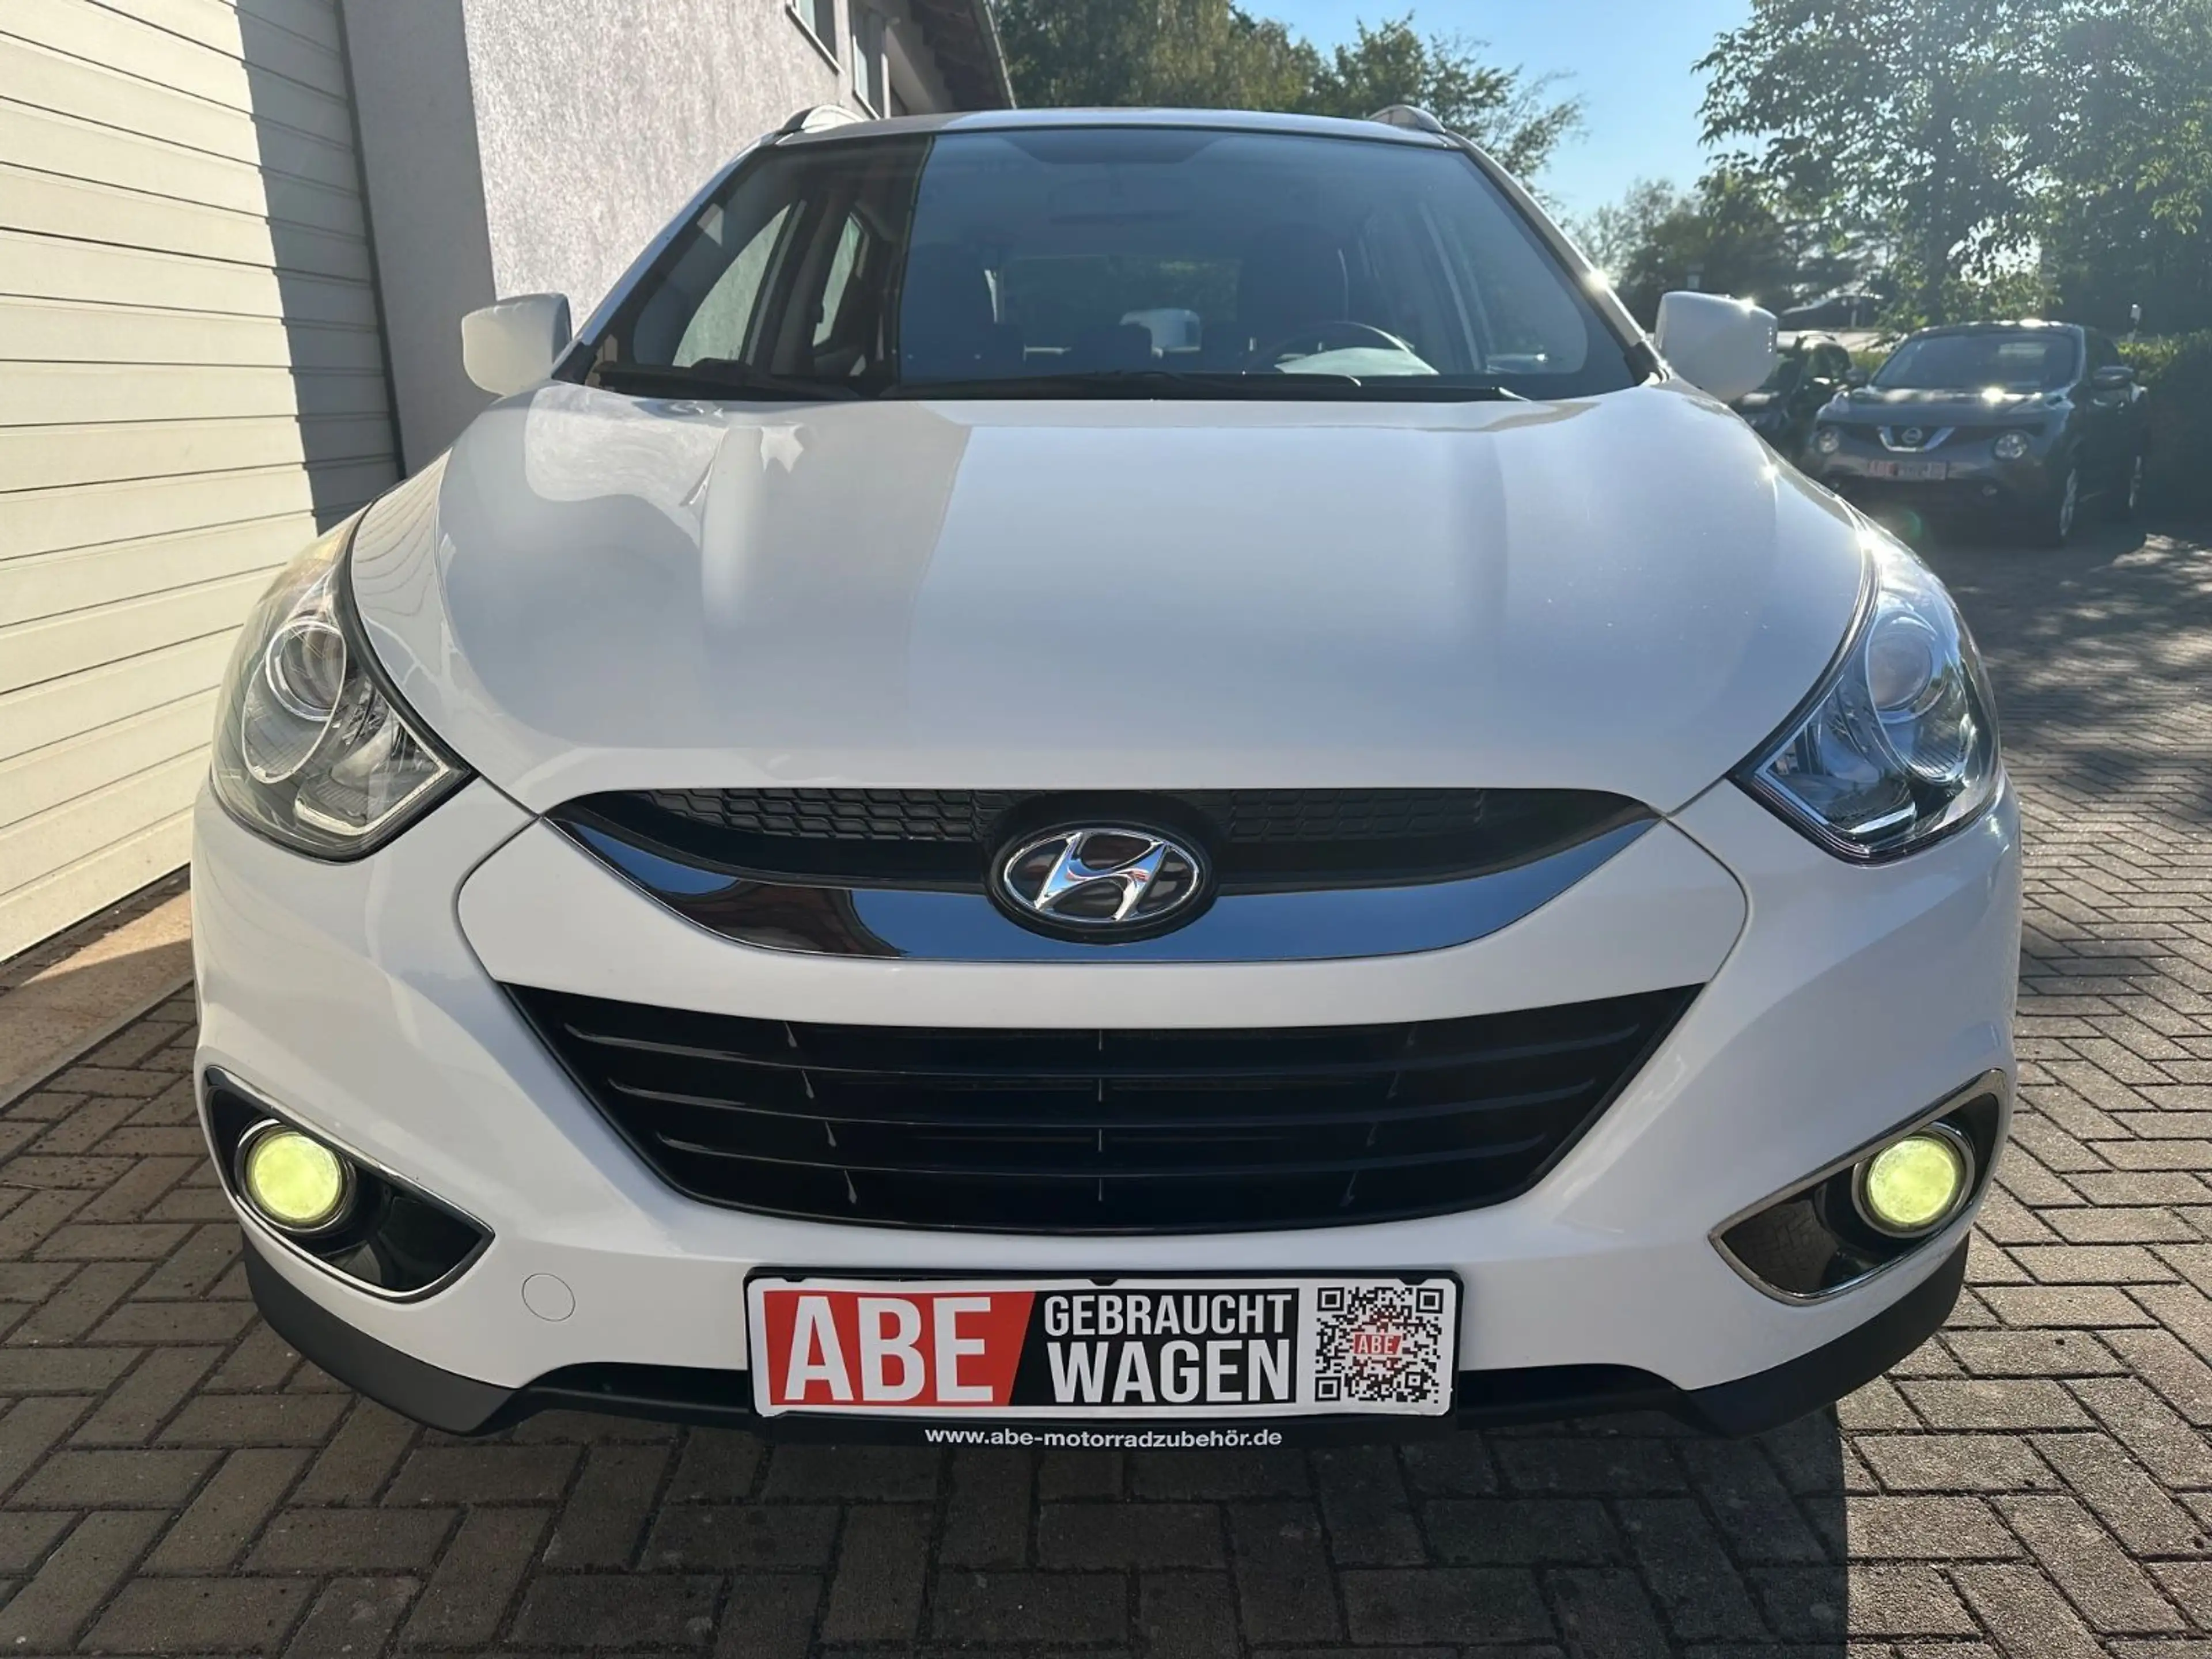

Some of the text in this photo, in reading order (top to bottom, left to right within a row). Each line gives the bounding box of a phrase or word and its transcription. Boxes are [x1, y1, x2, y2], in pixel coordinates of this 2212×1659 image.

[1044, 1294, 1292, 1336] GEBRAUCHT
[784, 1296, 993, 1402] ABE
[1358, 1335, 1395, 1354] ABE
[1046, 1339, 1290, 1403] WAGEN
[925, 1428, 1282, 1447] www.abe-motorradzubehör.de
